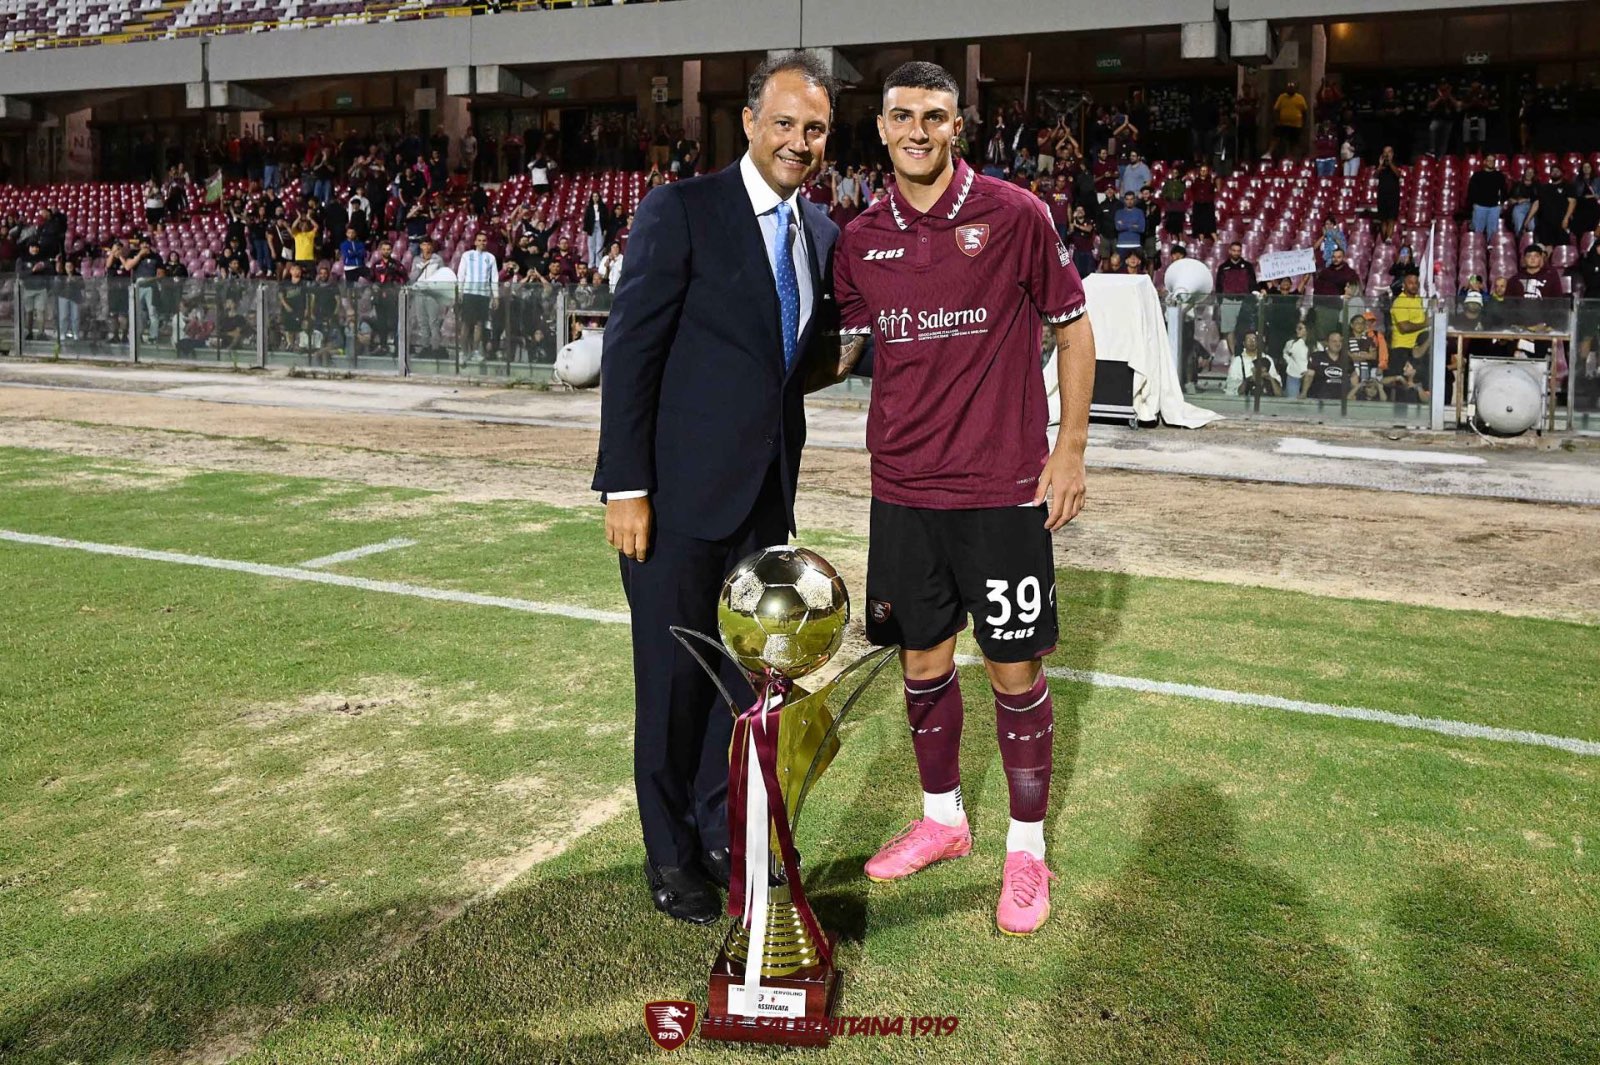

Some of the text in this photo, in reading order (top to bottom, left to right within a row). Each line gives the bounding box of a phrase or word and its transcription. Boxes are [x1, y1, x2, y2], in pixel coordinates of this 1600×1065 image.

[1096, 58, 1121, 67] USCITA
[917, 307, 987, 330] Salerno
[985, 575, 1041, 626] 39
[757, 1003, 789, 1012] ASSIFICATA
